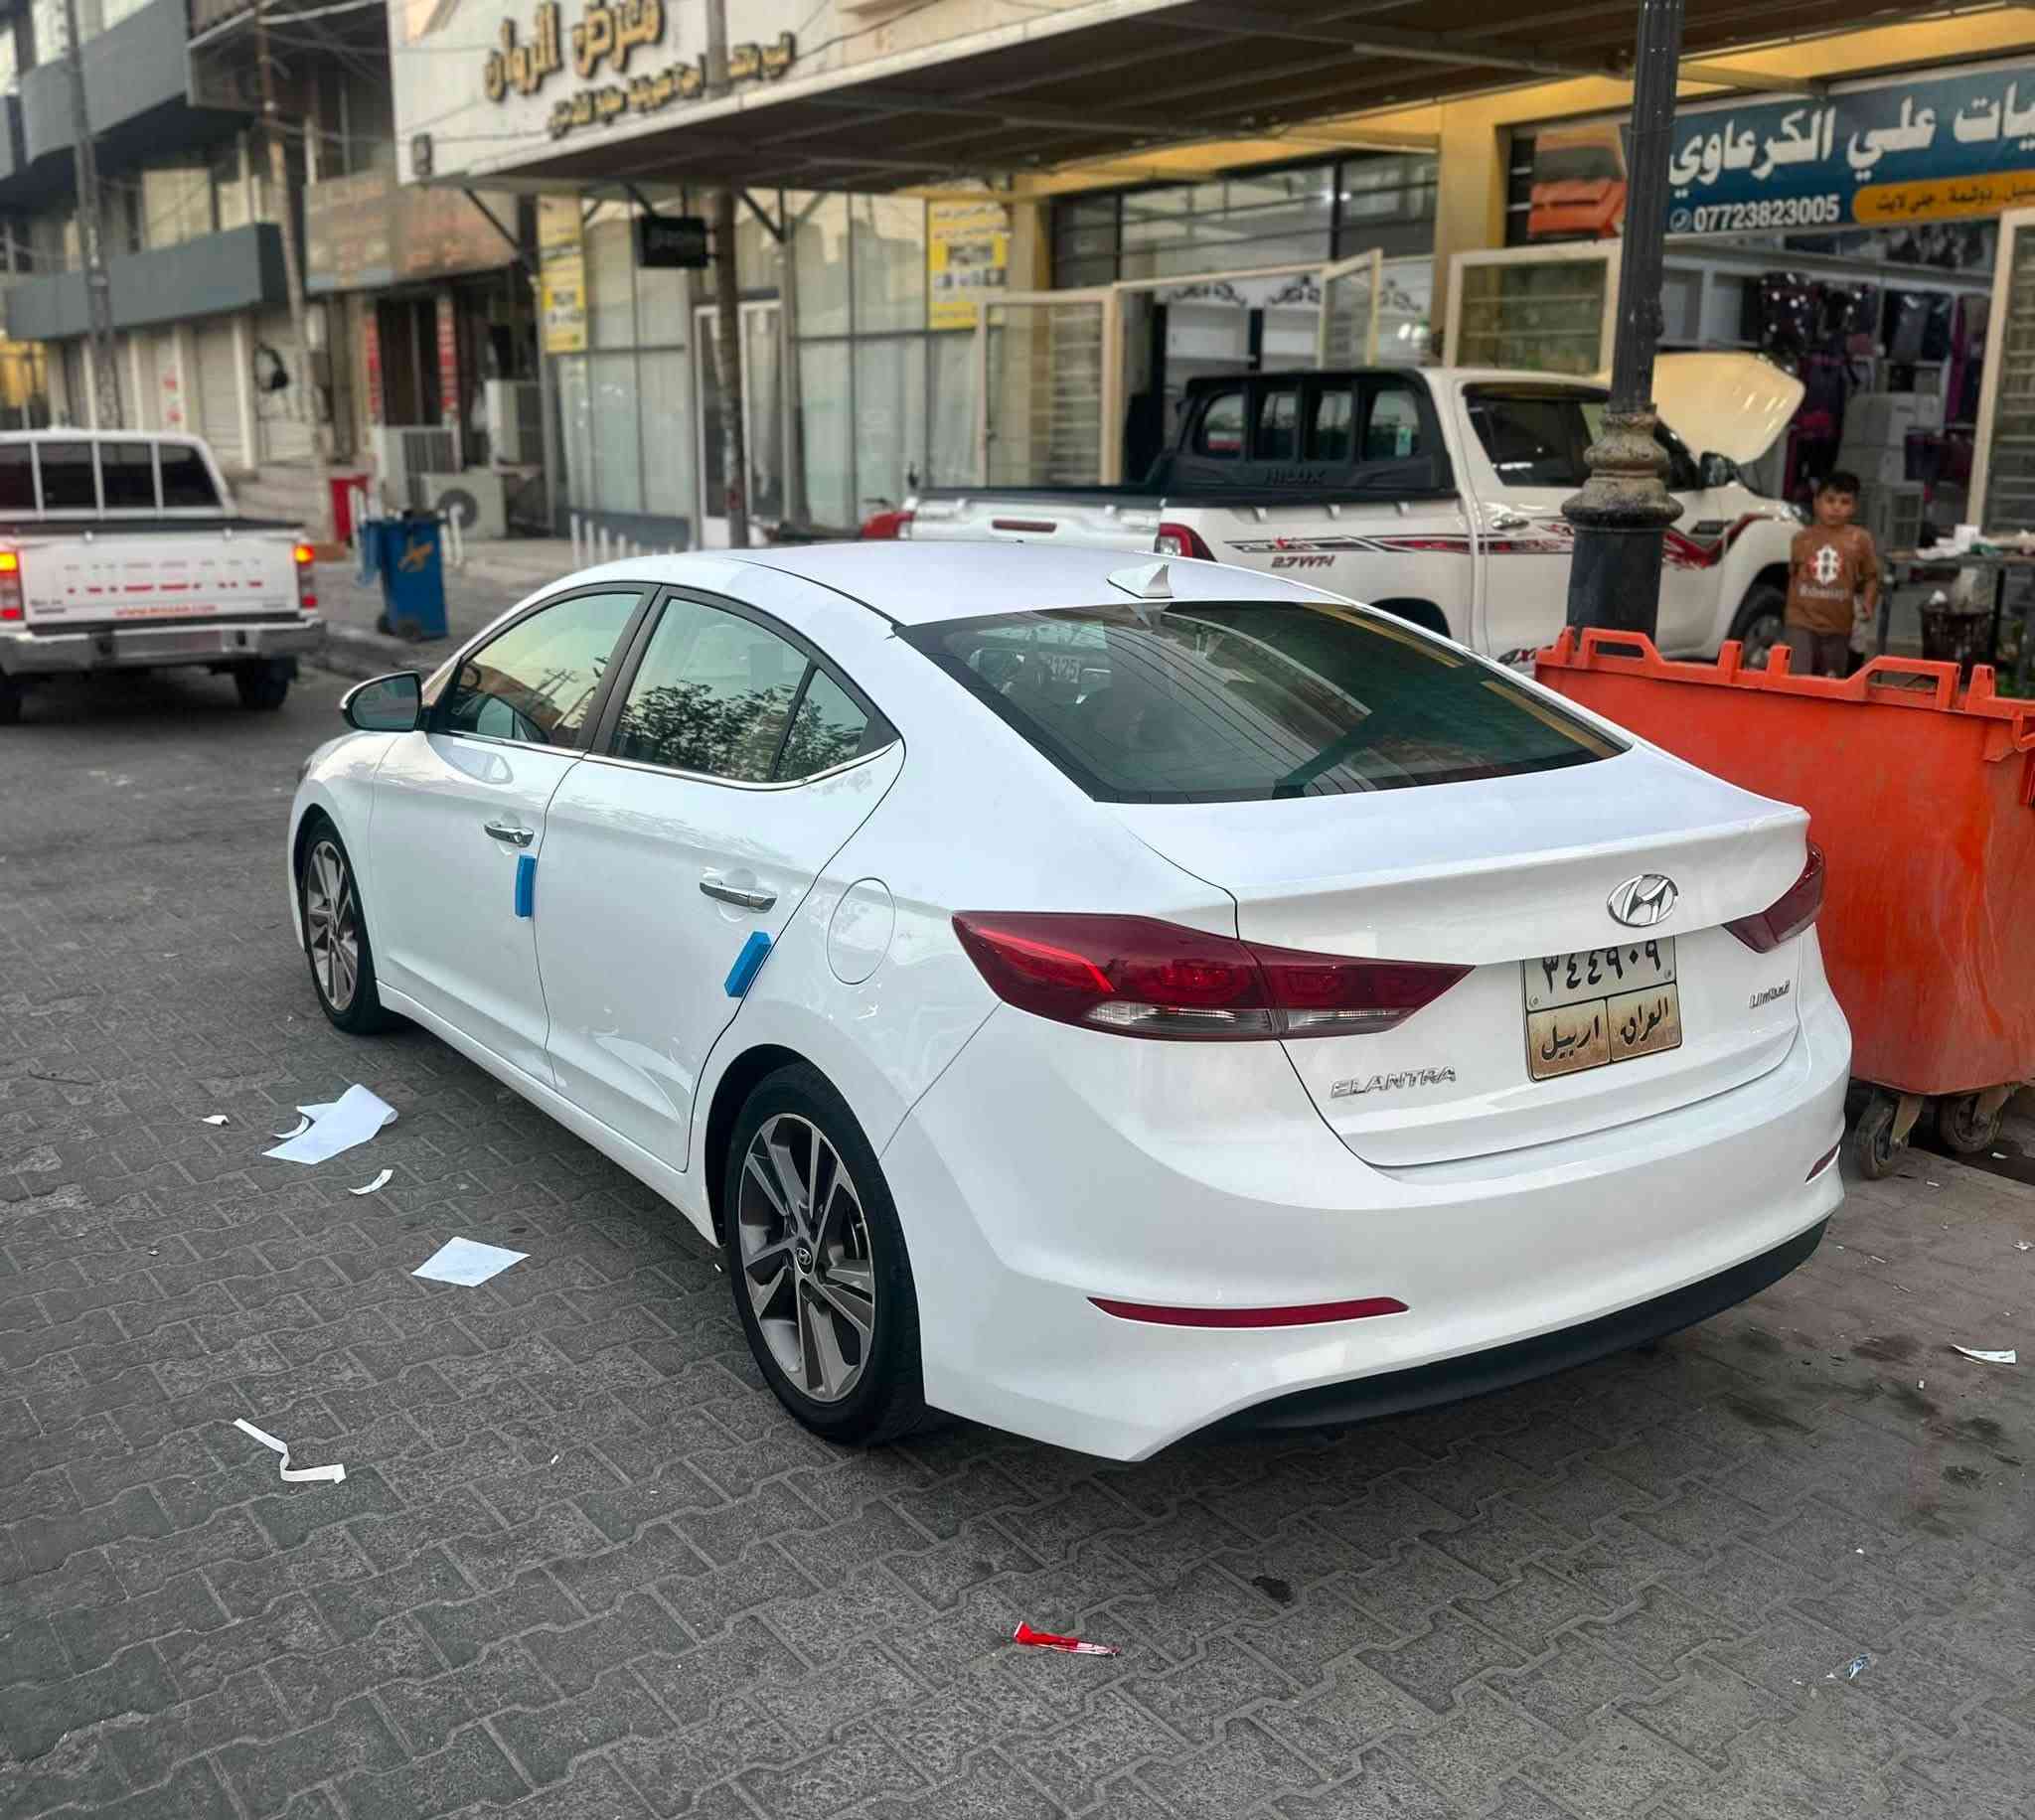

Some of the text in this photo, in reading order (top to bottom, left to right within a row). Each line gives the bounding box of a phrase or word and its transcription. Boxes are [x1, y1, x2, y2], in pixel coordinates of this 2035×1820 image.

[1668, 80, 2035, 199] يات علي الكرعاوي
[1693, 194, 1841, 232] 07723823005
[1541, 1014, 1600, 1060] اربيل
[1620, 995, 1669, 1045] العراق
[1330, 1066, 1457, 1099] ELANTRA
